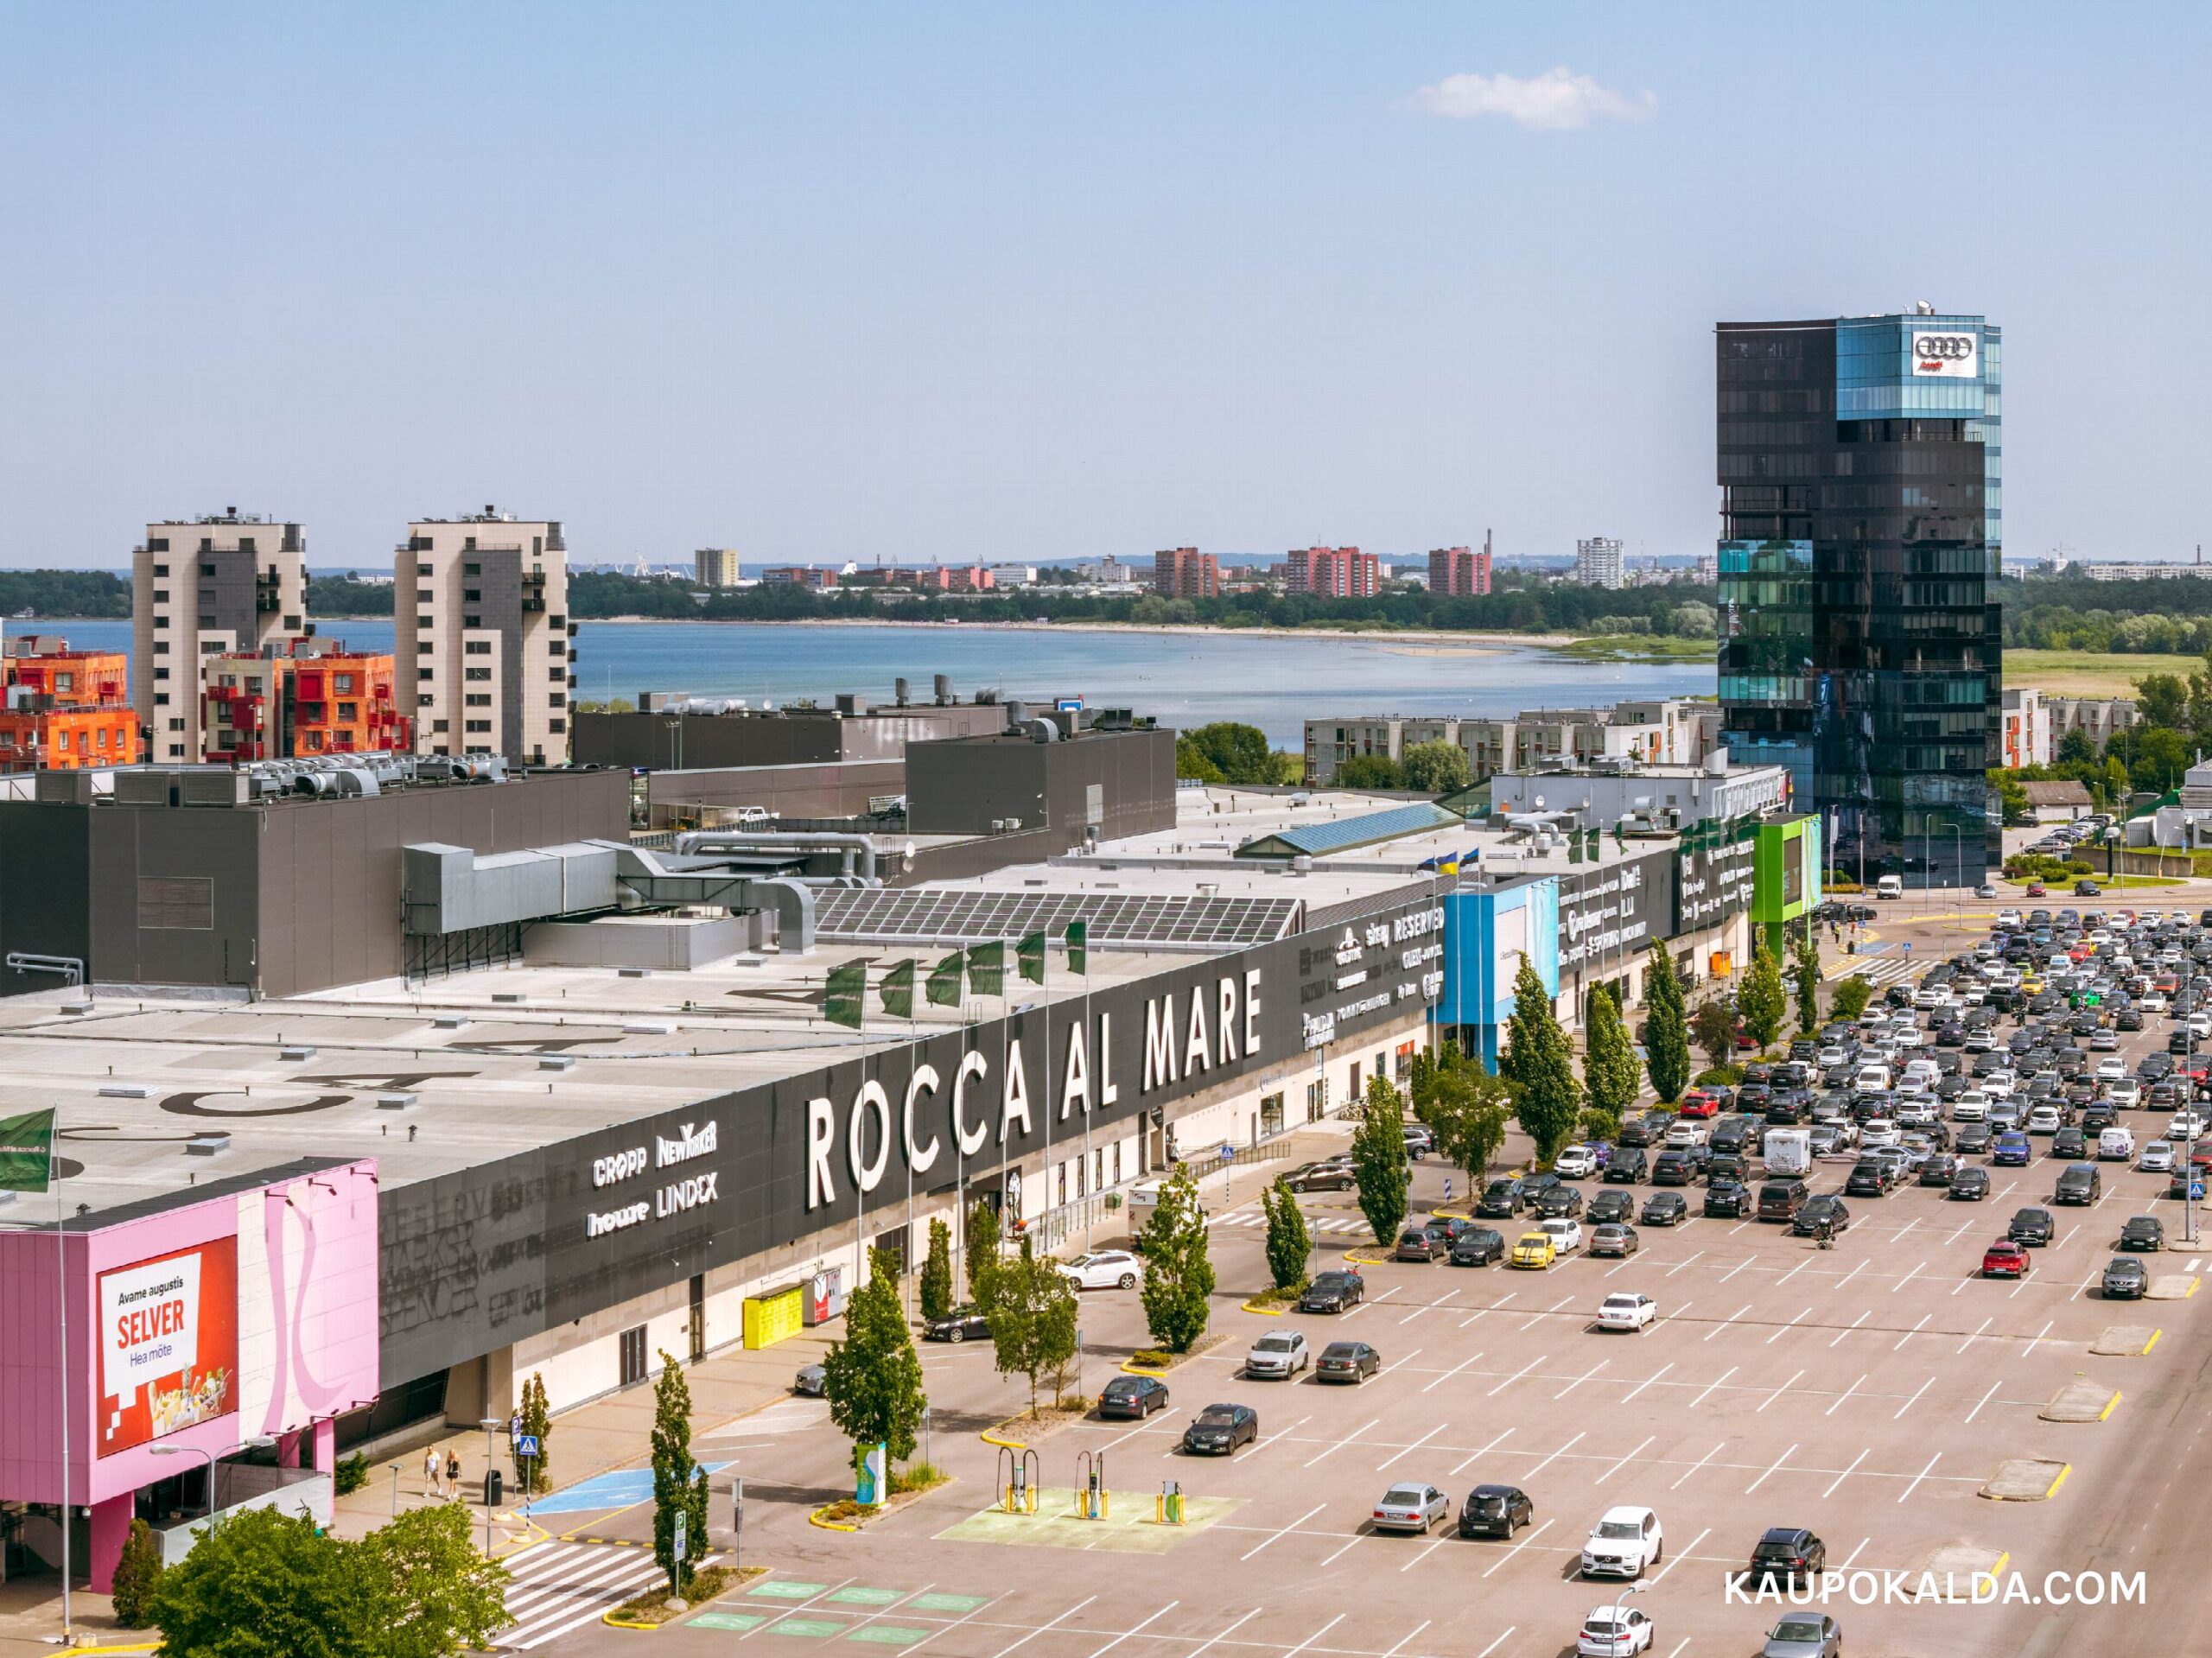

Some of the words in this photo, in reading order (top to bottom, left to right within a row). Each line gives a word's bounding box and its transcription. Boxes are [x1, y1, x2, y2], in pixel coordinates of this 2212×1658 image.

[1394, 907, 1445, 942] RESERVED
[808, 1040, 1032, 1209] ROCCA
[1061, 1013, 1117, 1119] AL
[1144, 969, 1262, 1091] MARE
[594, 1147, 646, 1186] CROPP
[587, 1202, 649, 1236] house
[656, 1172, 718, 1217] LINDEX
[118, 1288, 147, 1305] Avame
[149, 1276, 184, 1296] augustis
[118, 1299, 184, 1349] SELVER
[130, 1352, 148, 1367] Hea
[149, 1344, 172, 1362] mõte
